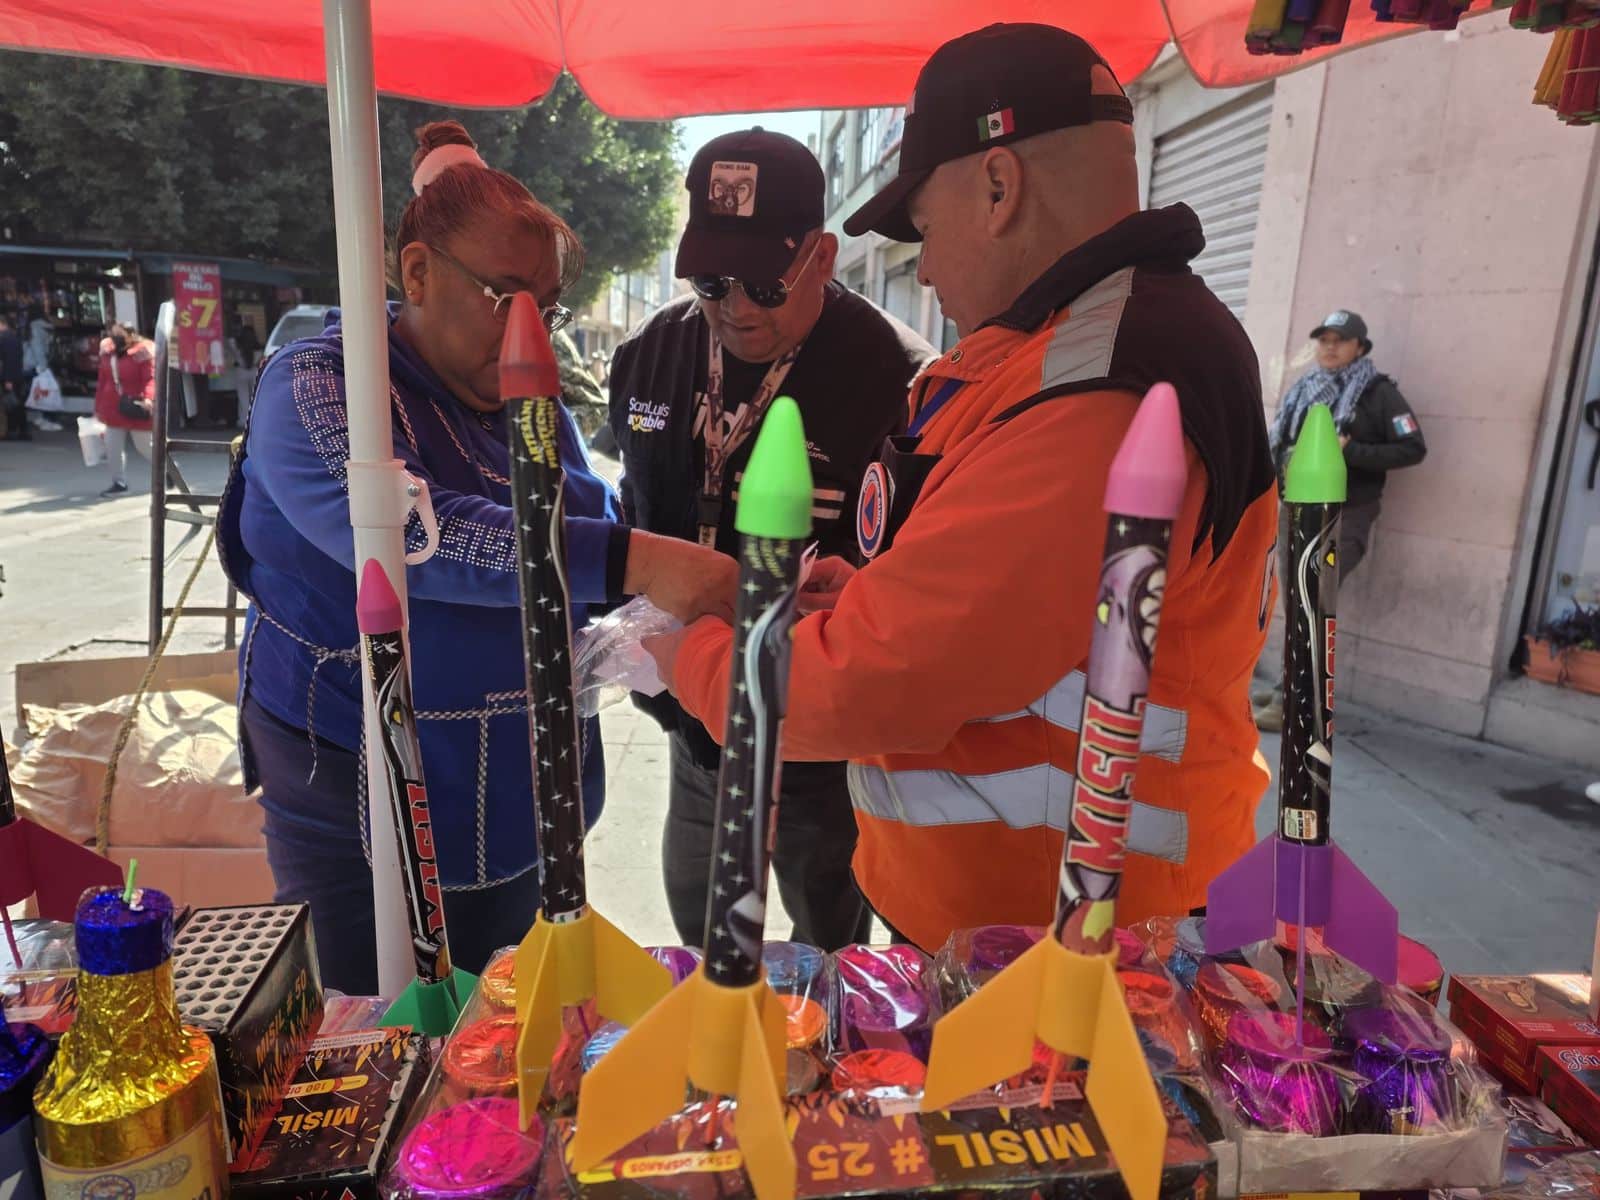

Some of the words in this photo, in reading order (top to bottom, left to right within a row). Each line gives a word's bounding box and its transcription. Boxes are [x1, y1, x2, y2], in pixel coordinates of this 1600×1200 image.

[521, 400, 545, 464] ARTESANI
[536, 398, 559, 469] PIROTECNI
[279, 1105, 360, 1135] MISIL
[807, 1142, 875, 1180] 25
[889, 1137, 925, 1175] #
[935, 1123, 1097, 1168] MISIL
